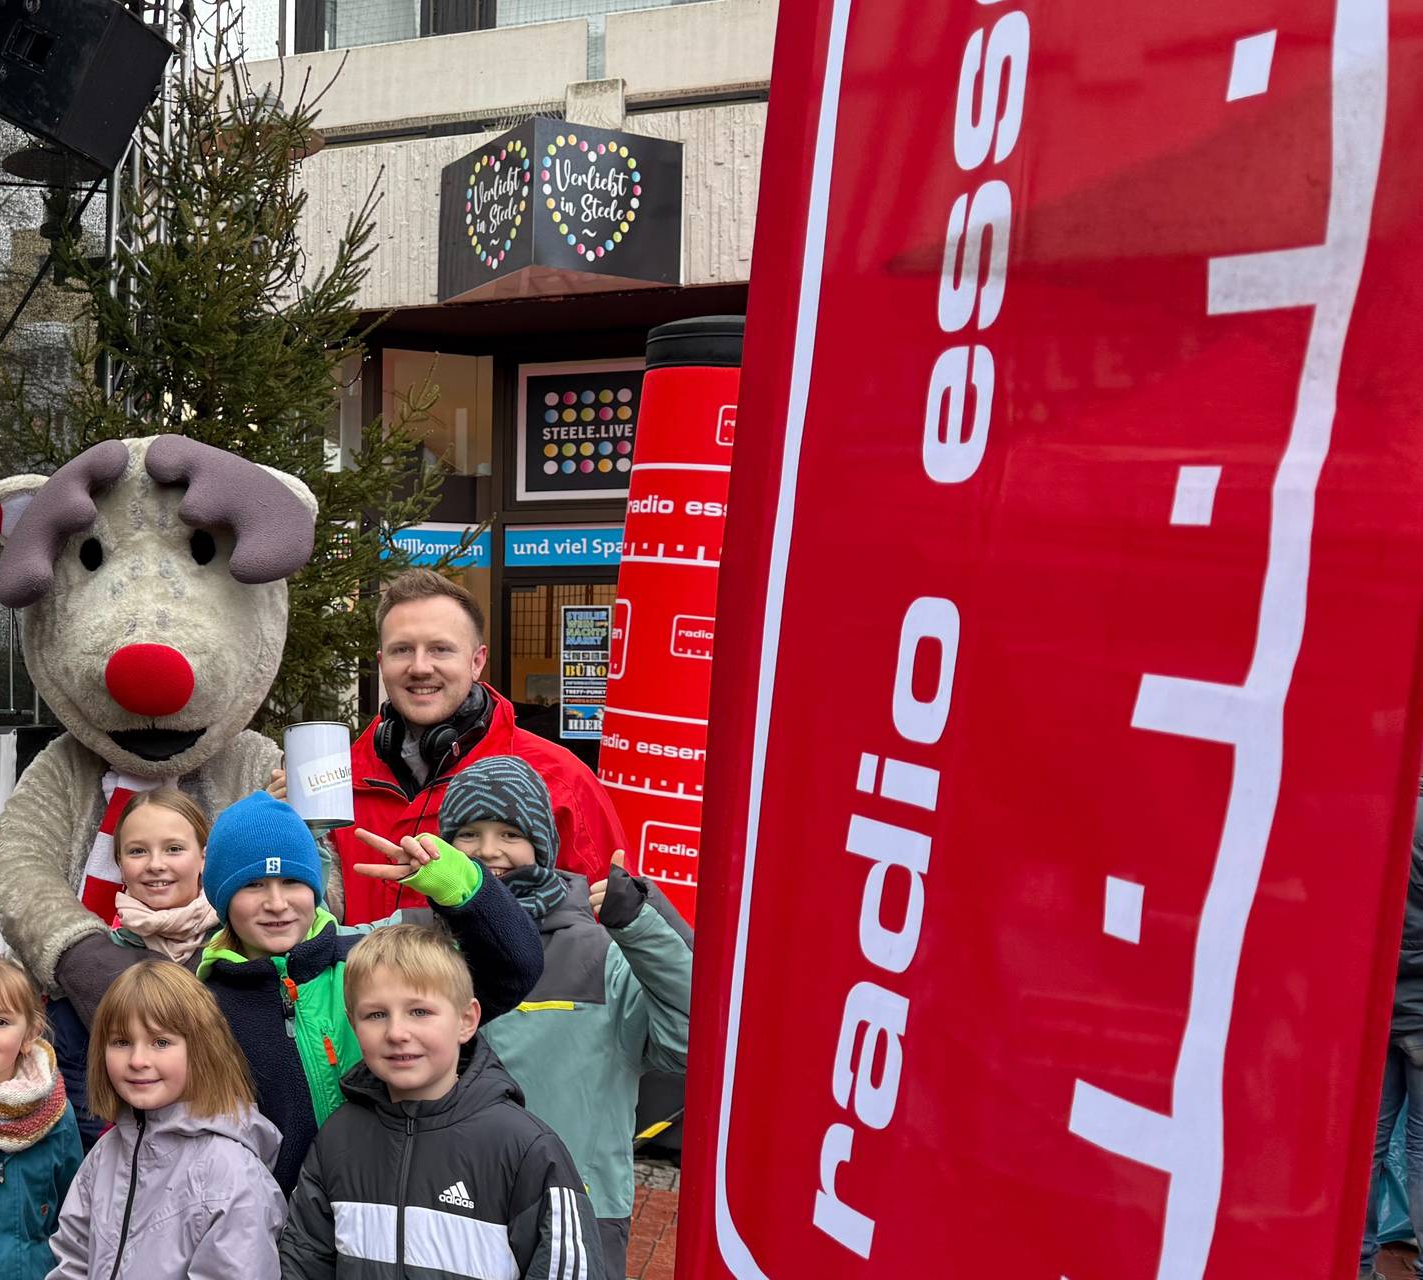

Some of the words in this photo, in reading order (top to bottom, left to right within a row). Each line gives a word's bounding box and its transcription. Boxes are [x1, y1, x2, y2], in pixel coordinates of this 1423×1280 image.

[555, 158, 629, 197] Verliebt
[473, 165, 522, 215] Verliebt
[476, 217, 487, 235] in
[489, 197, 519, 235] Steele
[560, 197, 576, 216] in
[581, 193, 626, 223] Steele
[922, 0, 1030, 484] ess
[542, 424, 634, 441] STEELE.LIVE
[685, 500, 728, 517] es
[513, 540, 550, 556] und
[554, 537, 588, 556] viel
[678, 629, 714, 639] radio
[565, 663, 607, 677] BÜRO
[648, 842, 699, 858] radio
[813, 597, 961, 1259] radio
[438, 1192, 475, 1209] adidas
